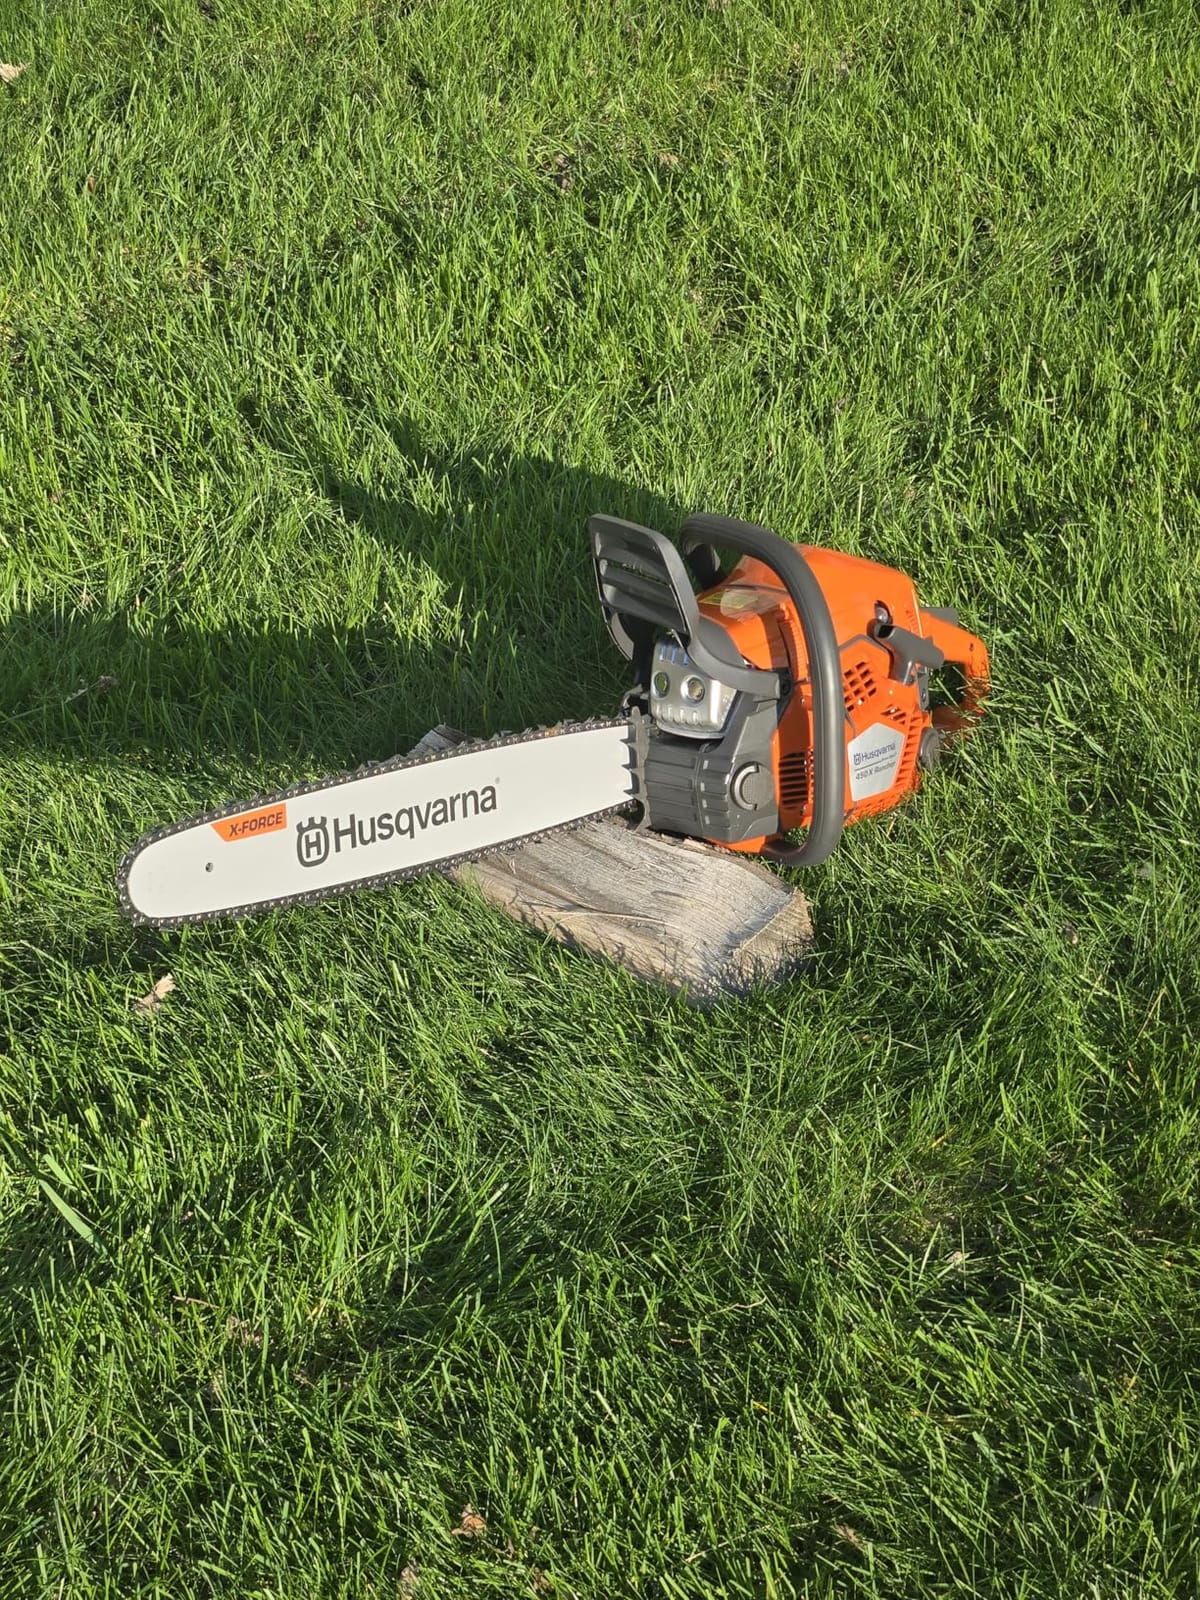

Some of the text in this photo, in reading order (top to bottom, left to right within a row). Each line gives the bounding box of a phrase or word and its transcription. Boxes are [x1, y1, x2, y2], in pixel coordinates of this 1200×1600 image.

[862, 742, 896, 762] Husqvarna
[229, 811, 284, 837] X-FORCE
[334, 785, 497, 852] Husqvarna
